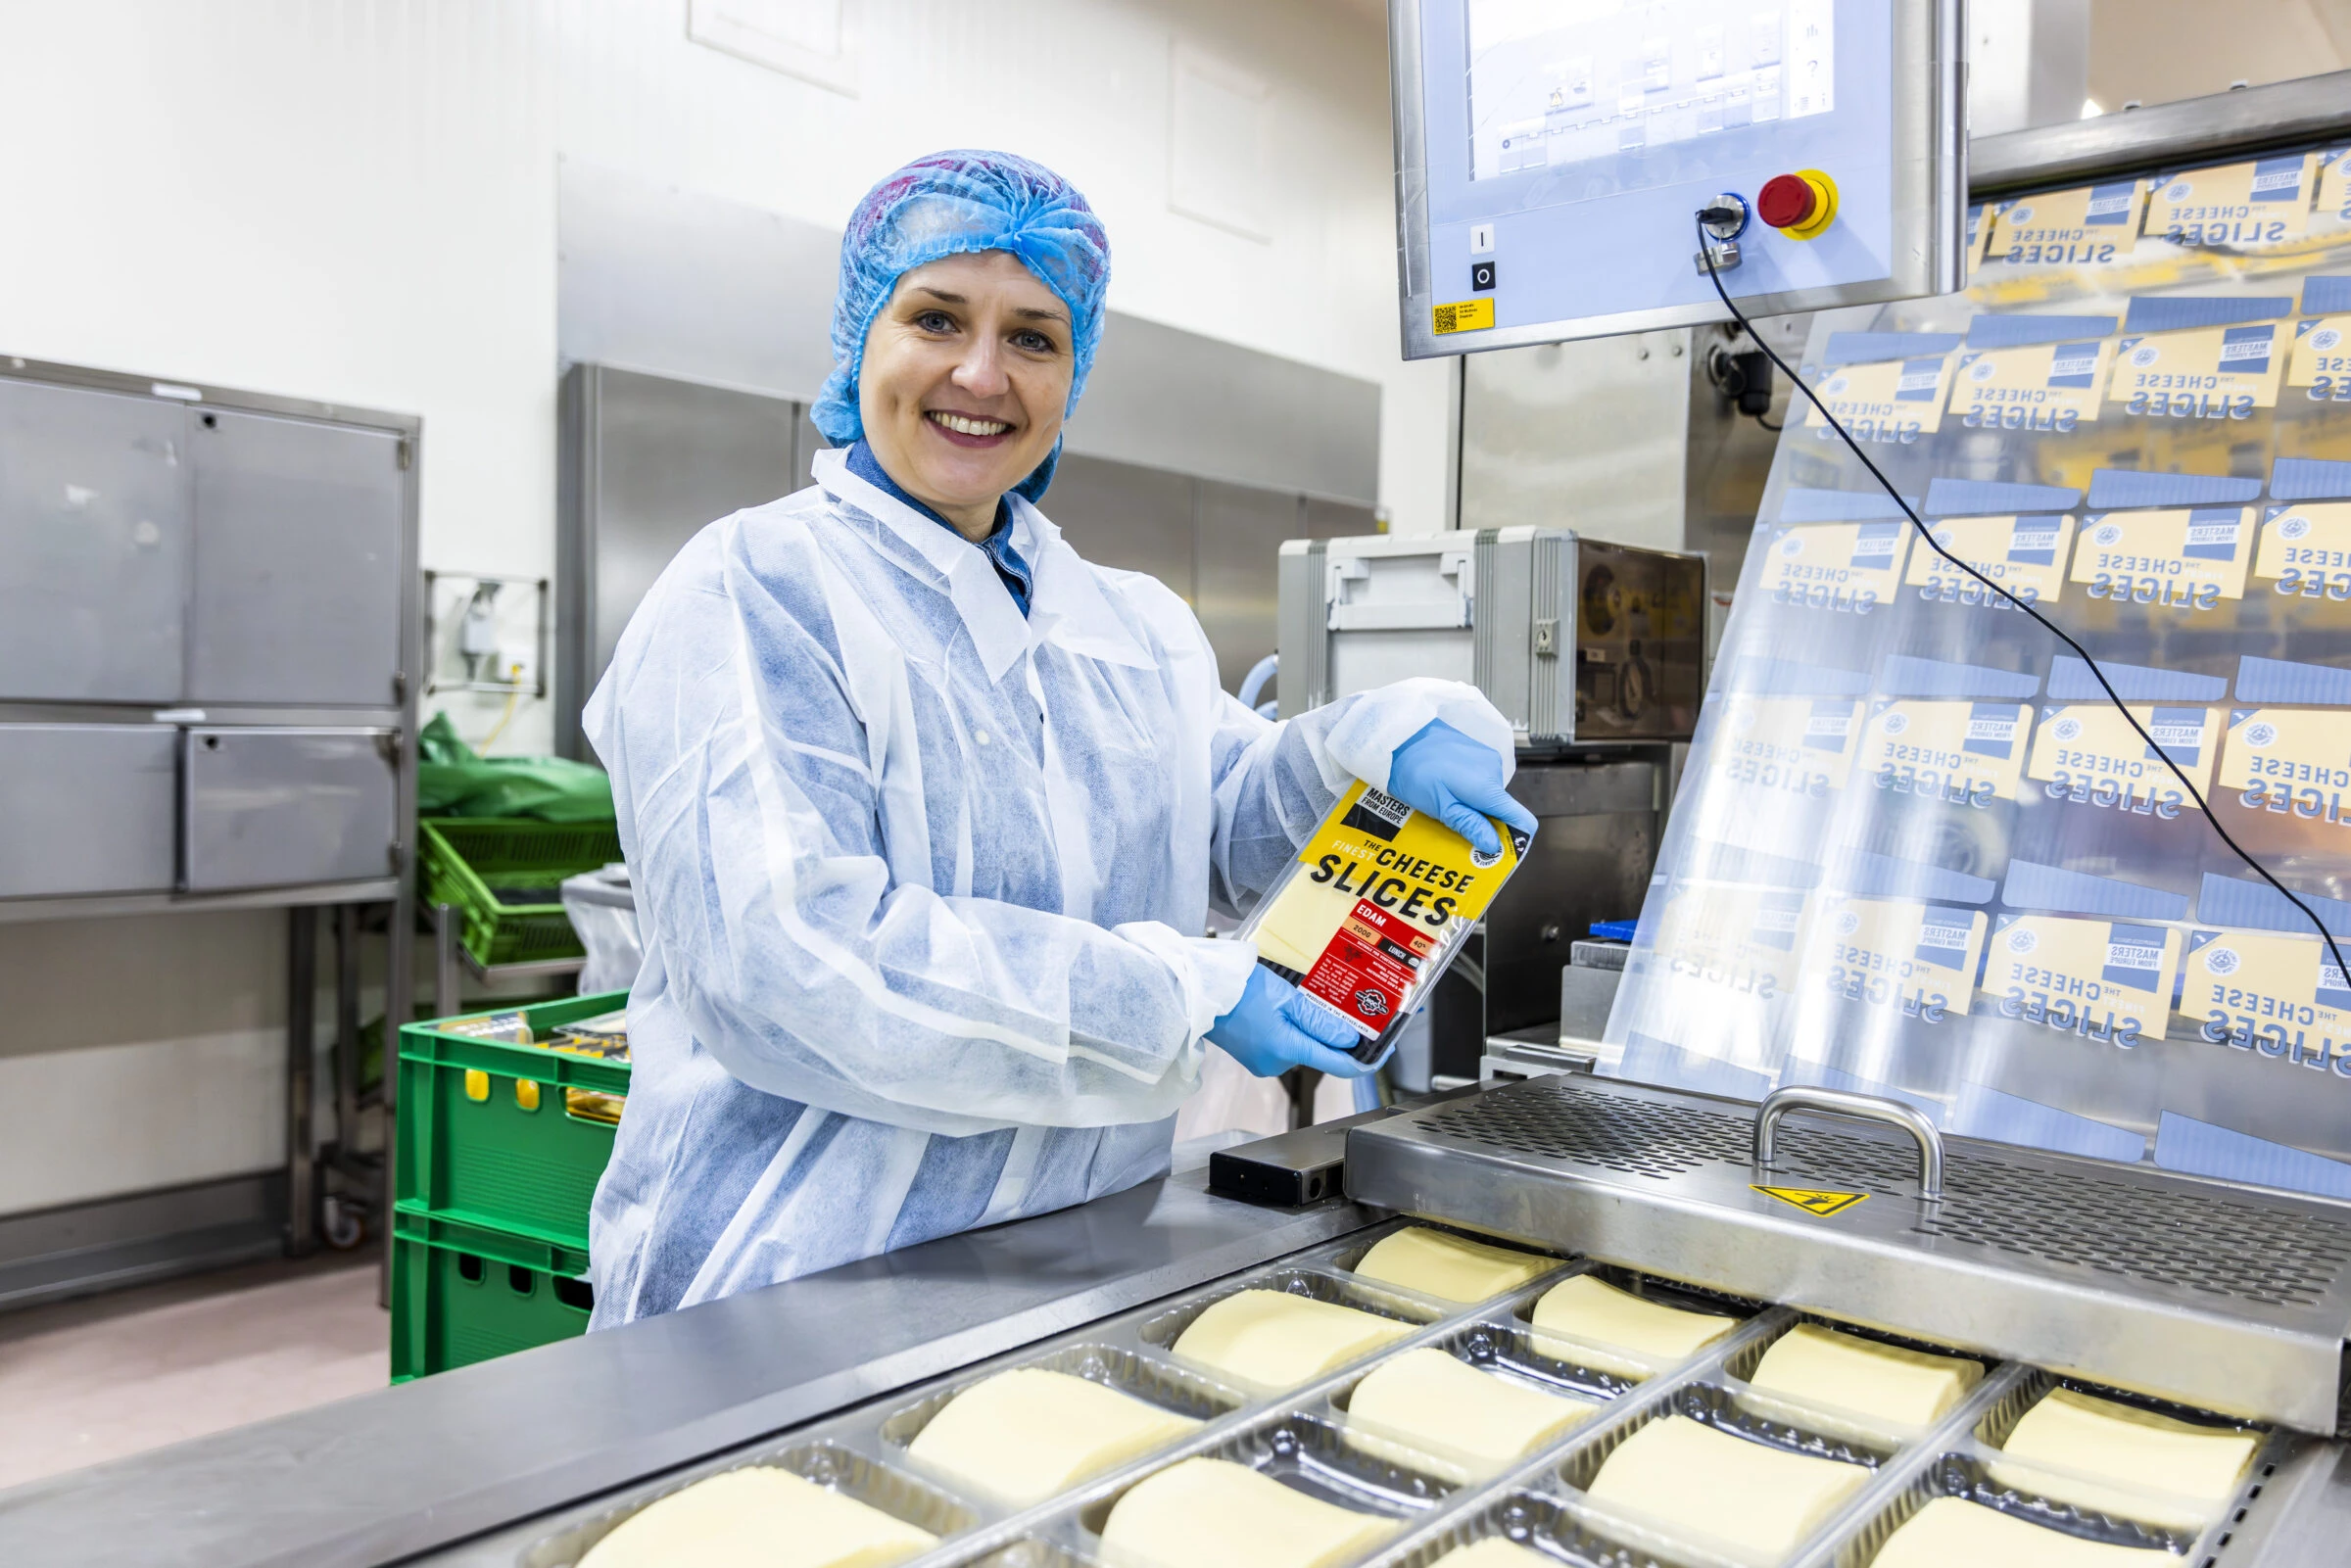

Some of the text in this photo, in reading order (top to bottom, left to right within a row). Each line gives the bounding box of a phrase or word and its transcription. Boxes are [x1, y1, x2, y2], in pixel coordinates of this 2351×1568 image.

[1361, 796, 1404, 825] FROM EUROPE
[1366, 786, 1411, 817] MASTERS
[1363, 839, 1382, 852] THE
[1331, 839, 1475, 895] FINEST CHEESE
[1310, 854, 1457, 926] SLICES
[1356, 904, 1387, 927] EDAM
[1352, 924, 1371, 939] 200G
[1388, 944, 1407, 960] LUNCH
[1305, 992, 1327, 1009] PRODUCED
